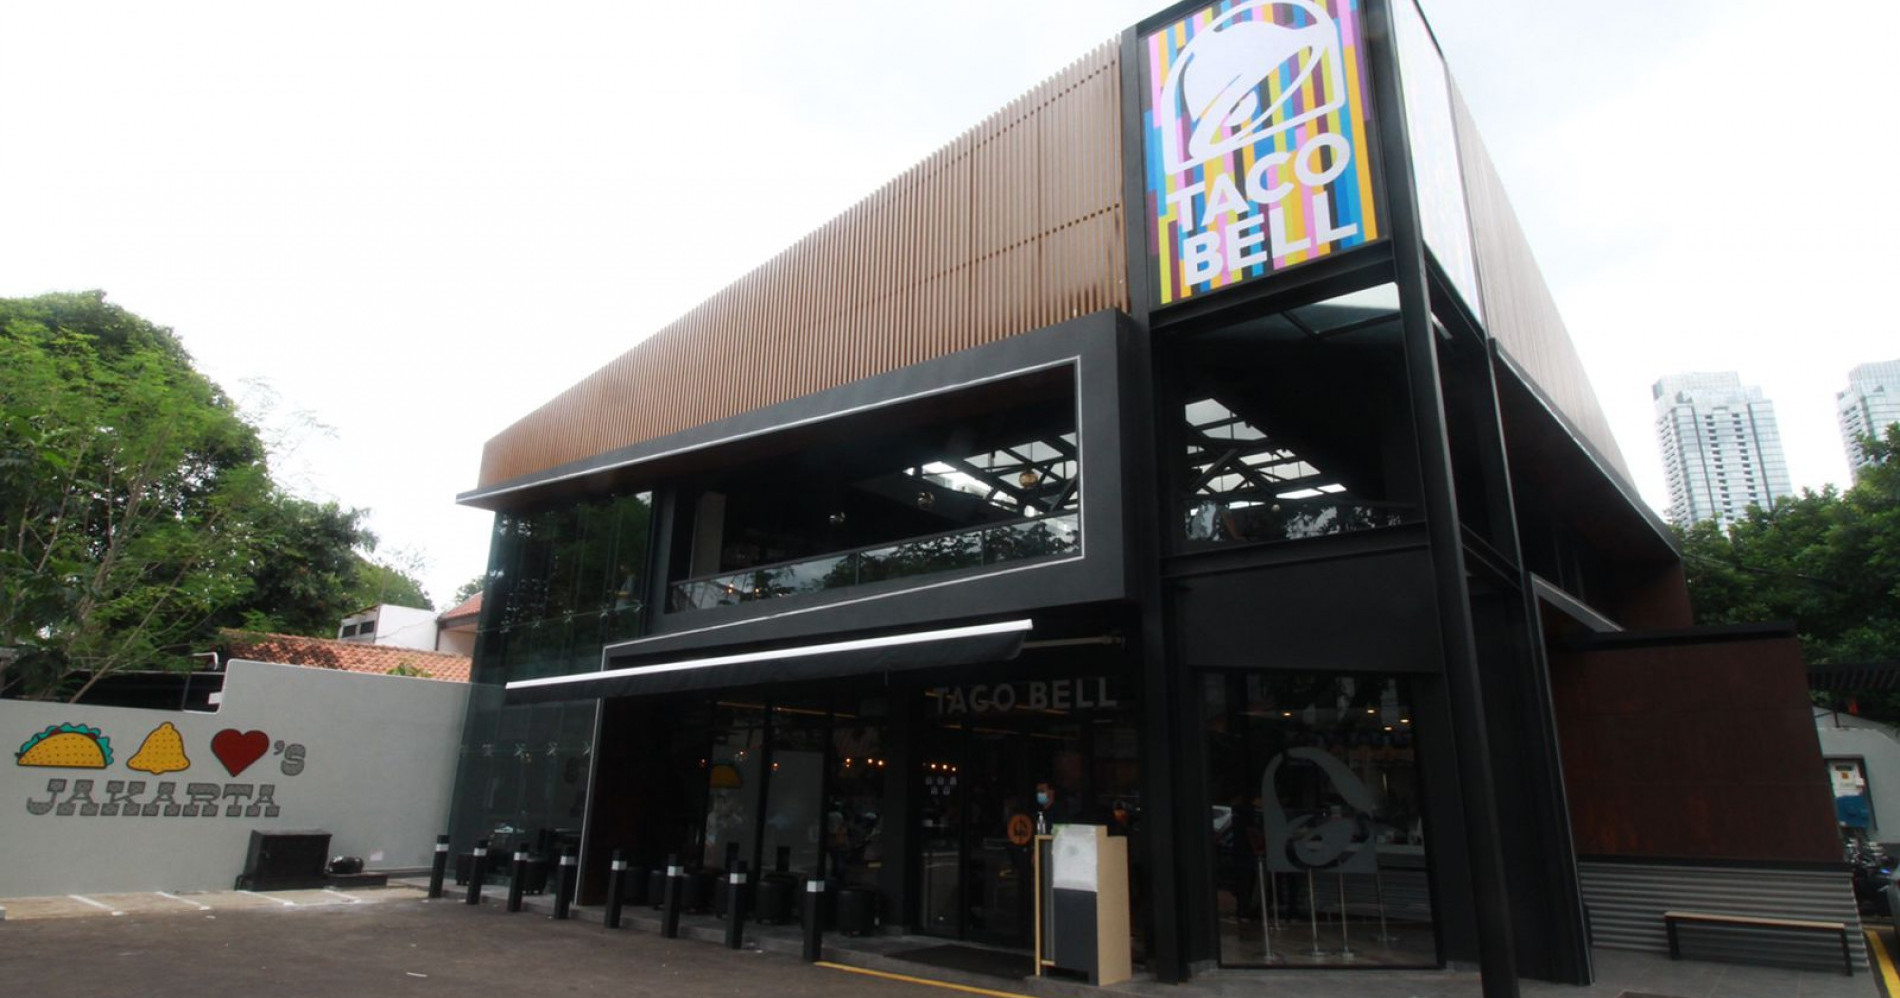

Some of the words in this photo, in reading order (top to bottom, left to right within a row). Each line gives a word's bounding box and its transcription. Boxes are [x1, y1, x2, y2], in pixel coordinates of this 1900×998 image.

[1166, 132, 1351, 233] TACO
[1183, 191, 1358, 286] BELL
[1028, 677, 1118, 710] BELL
[26, 778, 281, 817] JAKARTA
